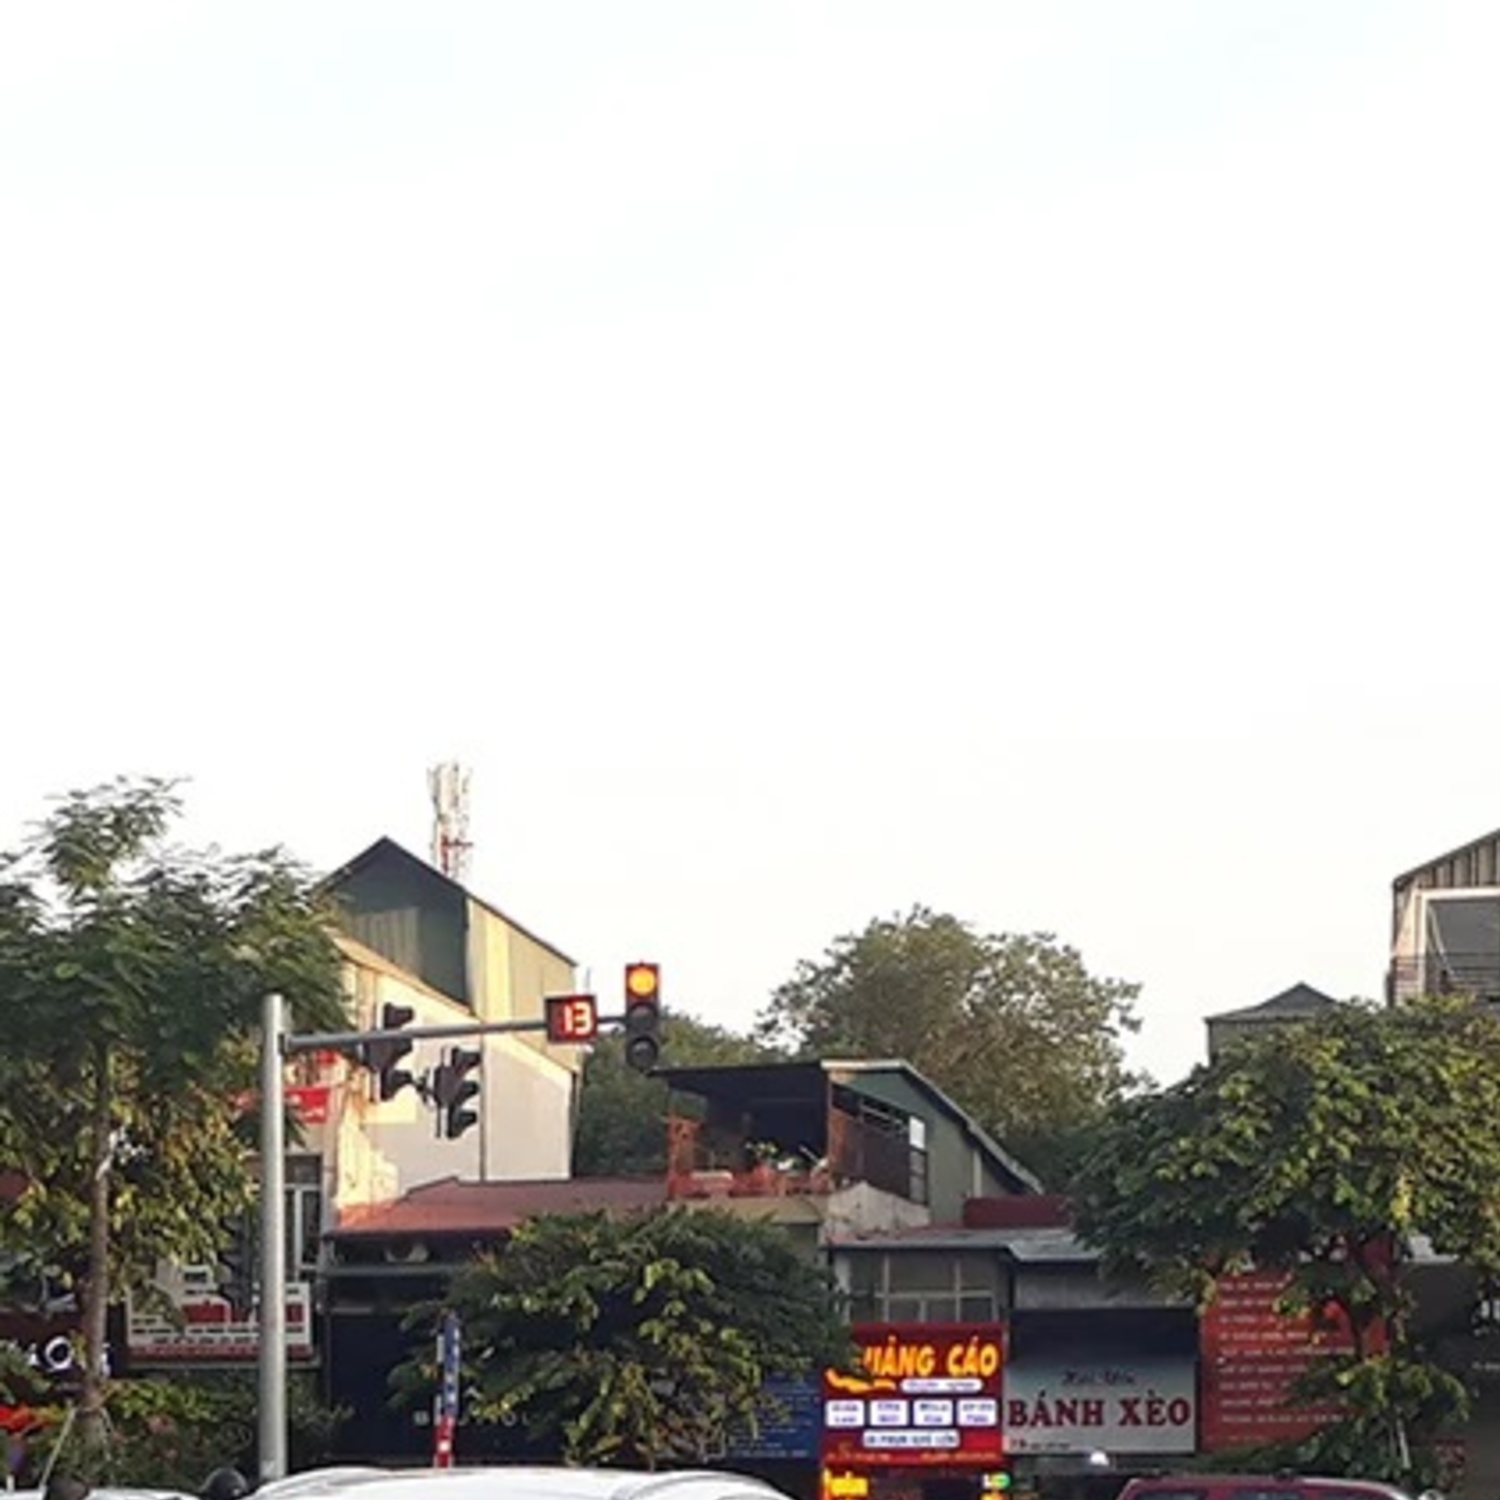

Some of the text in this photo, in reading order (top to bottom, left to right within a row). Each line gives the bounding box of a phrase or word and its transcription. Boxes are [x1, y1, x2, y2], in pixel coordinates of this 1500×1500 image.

[564, 1002, 592, 1035] 13
[861, 1335, 998, 1377] UẢNG CÁO
[1008, 1389, 1105, 1427] BÁNH
